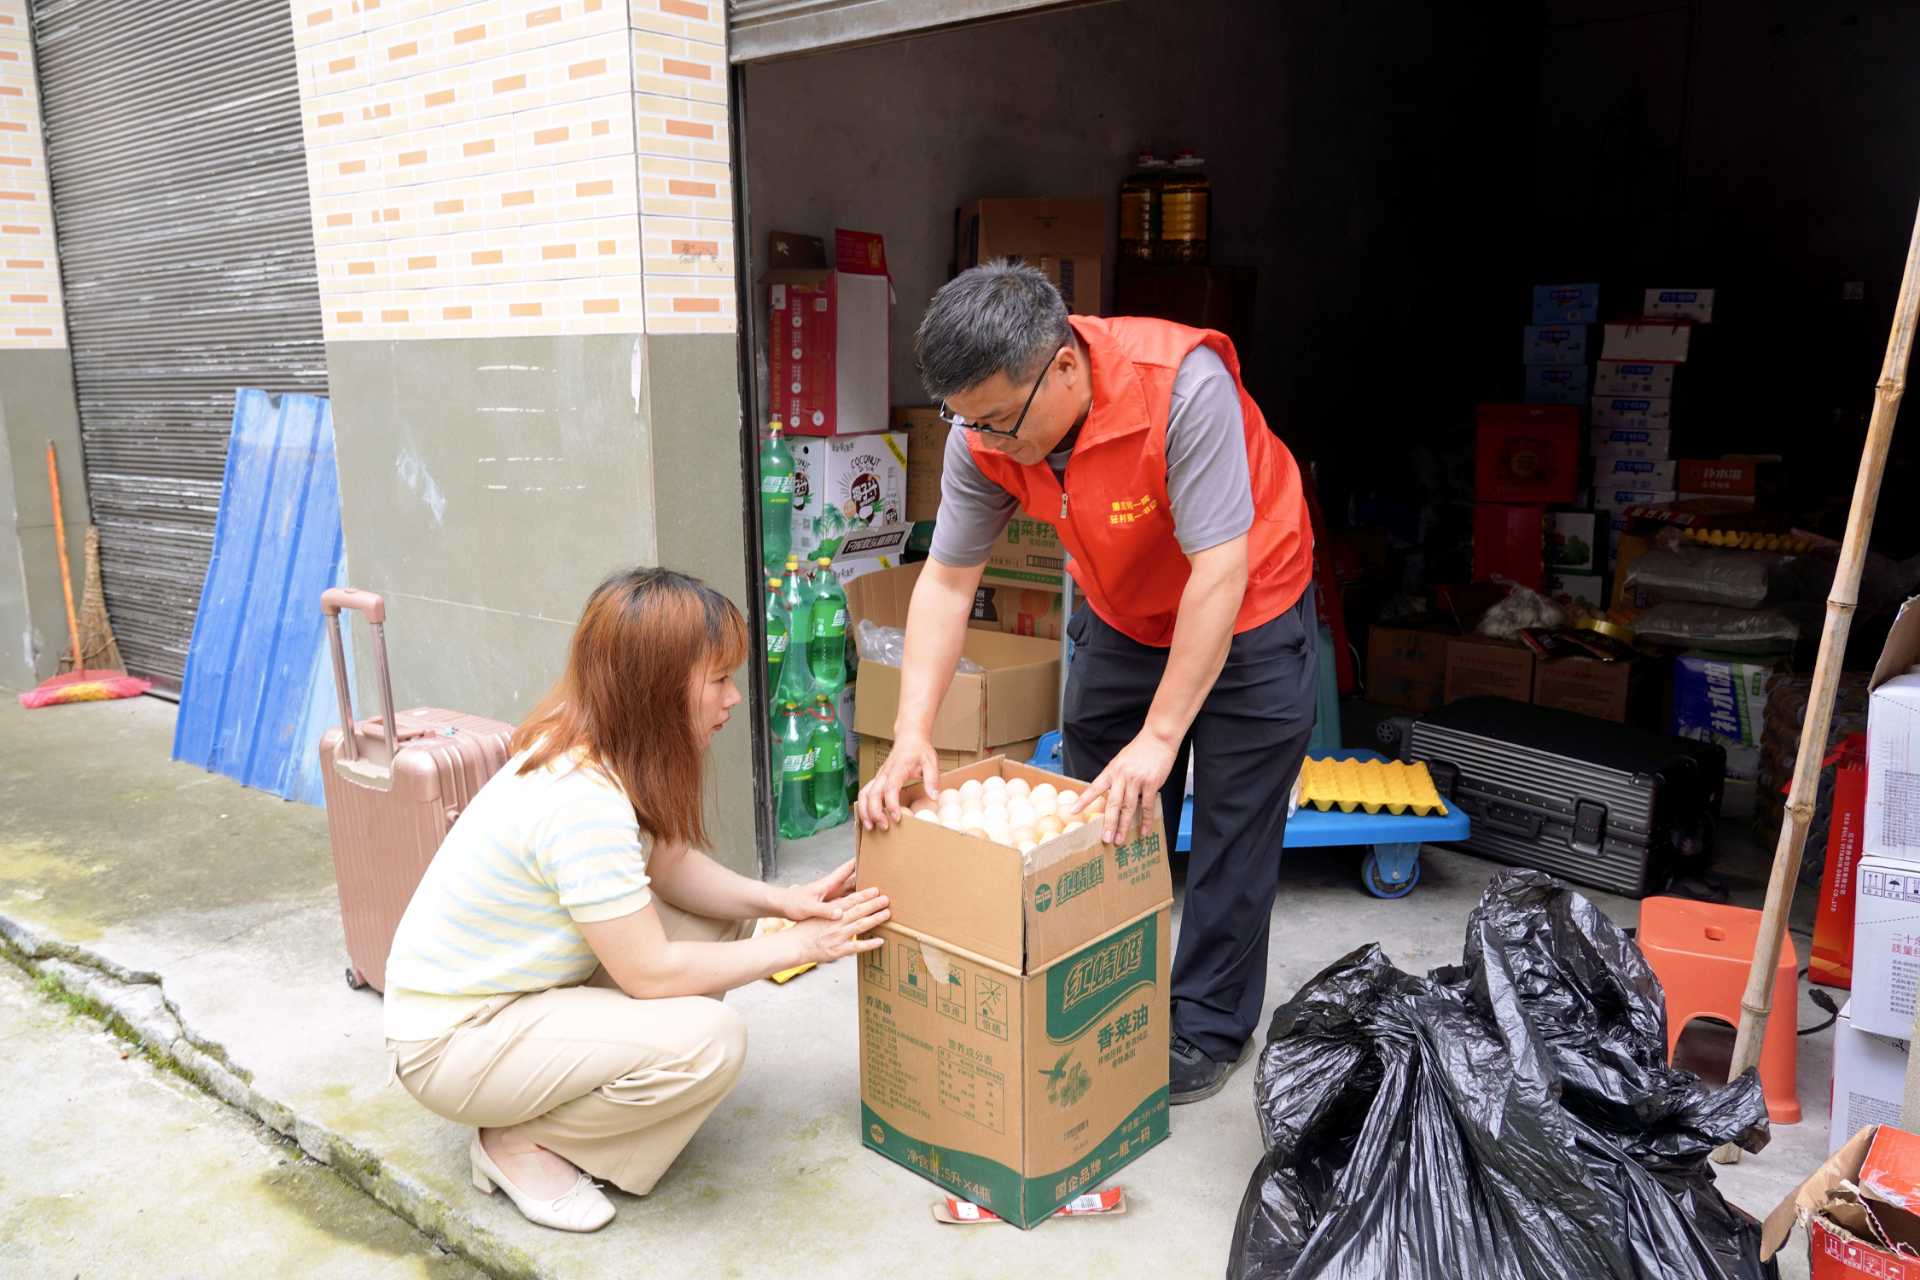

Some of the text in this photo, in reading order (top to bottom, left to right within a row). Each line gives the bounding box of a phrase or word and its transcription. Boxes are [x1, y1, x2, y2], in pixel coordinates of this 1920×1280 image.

[850, 454, 881, 469] COCONUT
[1098, 1003, 1148, 1053] 香菜油
